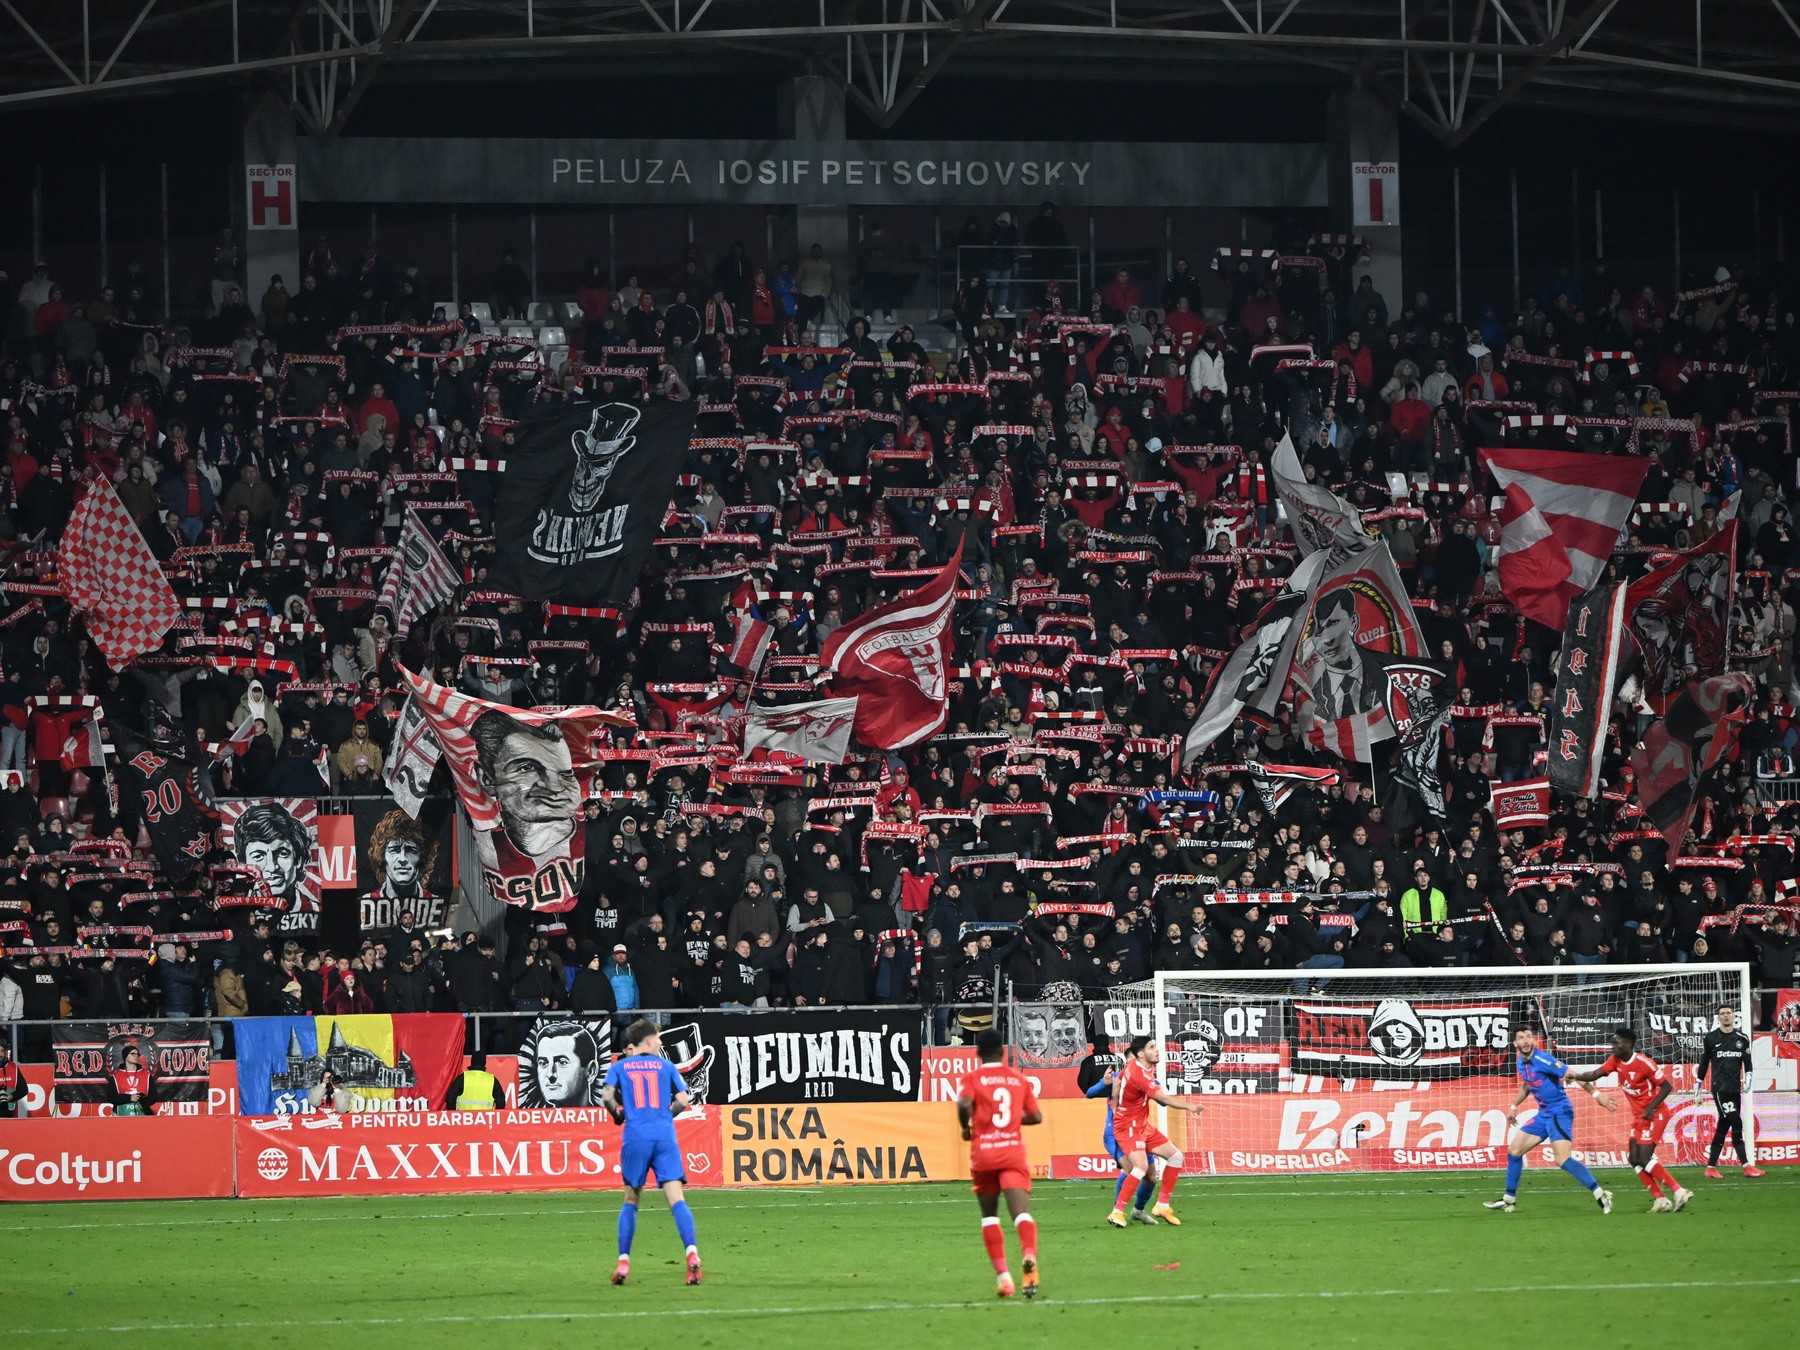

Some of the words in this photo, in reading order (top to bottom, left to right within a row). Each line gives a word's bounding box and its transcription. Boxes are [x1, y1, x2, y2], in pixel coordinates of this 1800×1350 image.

[249, 168, 293, 176] SECTOR
[552, 159, 691, 185] PELUZA
[718, 158, 808, 185] IOSIF
[821, 160, 1092, 187] PETSCHOVSKY
[1355, 166, 1396, 174] SECTOR
[251, 181, 292, 225] H
[1369, 178, 1382, 221] I
[497, 361, 514, 369] UTA
[516, 361, 538, 370] ARAD
[912, 383, 943, 393] ARAD
[795, 416, 811, 424] UTA
[813, 416, 833, 424] ARAD
[1603, 417, 1627, 425] ARAD
[332, 470, 349, 478] UTA
[350, 470, 373, 479] ARAD
[889, 537, 914, 545] ARAD
[25, 552, 50, 562] UTA
[1083, 550, 1104, 558] ANTI
[1120, 550, 1140, 559] VIOLA
[486, 591, 501, 599] UTA
[862, 628, 918, 656] FOTBAL
[1002, 634, 1072, 646] FAIR-PLAY
[1205, 647, 1222, 656] UTA
[147, 656, 164, 664] UTA
[166, 655, 190, 664] ARAD
[1014, 664, 1029, 674] UTA
[1031, 666, 1054, 677] ARAD
[1391, 671, 1432, 691] OYS
[1100, 724, 1123, 733] ARAD
[1056, 729, 1075, 738] 1945
[1076, 731, 1098, 740] ARAD
[995, 802, 1019, 811] FORZA
[1020, 802, 1039, 810] UTA
[875, 822, 898, 832] DOAR
[1513, 866, 1527, 875] RED
[1594, 862, 1620, 874] ARAD
[219, 896, 244, 905] DOAR
[253, 897, 275, 906] UTA
[1044, 903, 1068, 913] ANTI
[1082, 903, 1108, 914] VIOLA
[1329, 915, 1351, 926] ARAD
[1104, 1007, 1176, 1038] OUT
[1223, 1007, 1268, 1038] OF
[108, 1023, 156, 1038] ARAD
[1296, 1011, 1370, 1048] RED
[1423, 1016, 1509, 1050] BOYS
[1717, 1050, 1743, 1059] Betano
[56, 1046, 104, 1076] RED
[160, 1045, 210, 1074] CODE
[725, 1024, 911, 1102] NEUMAN'S
[627, 1071, 660, 1109] 11
[991, 1087, 1012, 1129] 3
[352, 1112, 422, 1129] PENTRU
[426, 1110, 501, 1130] BĂRBAȚI
[506, 1107, 609, 1129] ADEVĂRAȚI!
[732, 1105, 827, 1141] SIKA
[298, 1138, 623, 1184] MAXXIMUS.
[733, 1137, 928, 1183] ROMÂNIA
[1231, 1149, 1352, 1170] SUPERLIGA
[1393, 1146, 1497, 1167] SUPERBET
[8, 1149, 143, 1192] Colțuri
